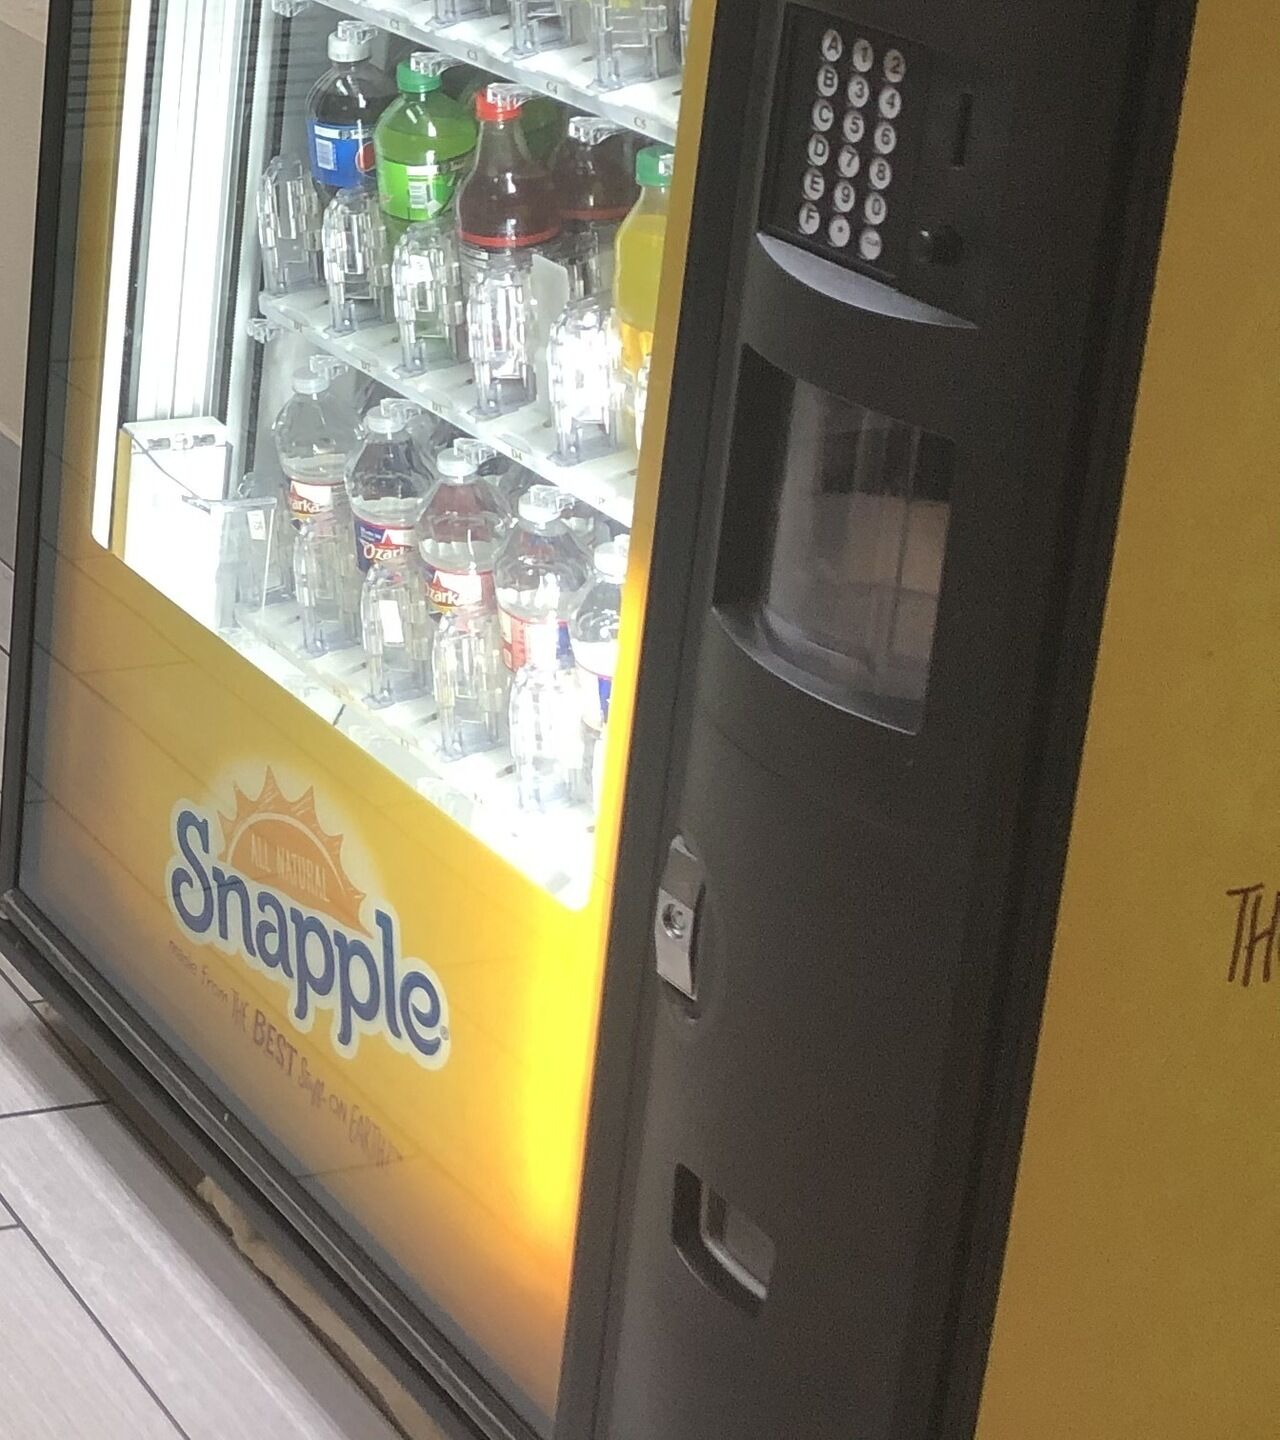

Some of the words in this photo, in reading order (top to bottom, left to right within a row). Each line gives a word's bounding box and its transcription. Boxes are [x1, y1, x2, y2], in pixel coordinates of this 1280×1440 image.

[827, 34, 841, 54] A
[861, 46, 869, 63] 1
[889, 56, 901, 74] 2
[545, 80, 559, 96] C4
[823, 68, 836, 89] B
[854, 81, 865, 99] 3
[886, 92, 897, 109] 4
[819, 105, 832, 123] C
[850, 115, 861, 134] 5
[881, 127, 892, 146] 6
[814, 139, 827, 157] D
[845, 150, 857, 168] 7
[876, 162, 887, 180] 8
[810, 174, 821, 193] E
[841, 185, 852, 203] 9
[805, 207, 817, 225] F
[511, 447, 523, 461] D4
[251, 833, 272, 873] ALL
[276, 844, 331, 903] NATURAL
[171, 810, 441, 1056] Snapple
[253, 1008, 298, 1077] BEST
